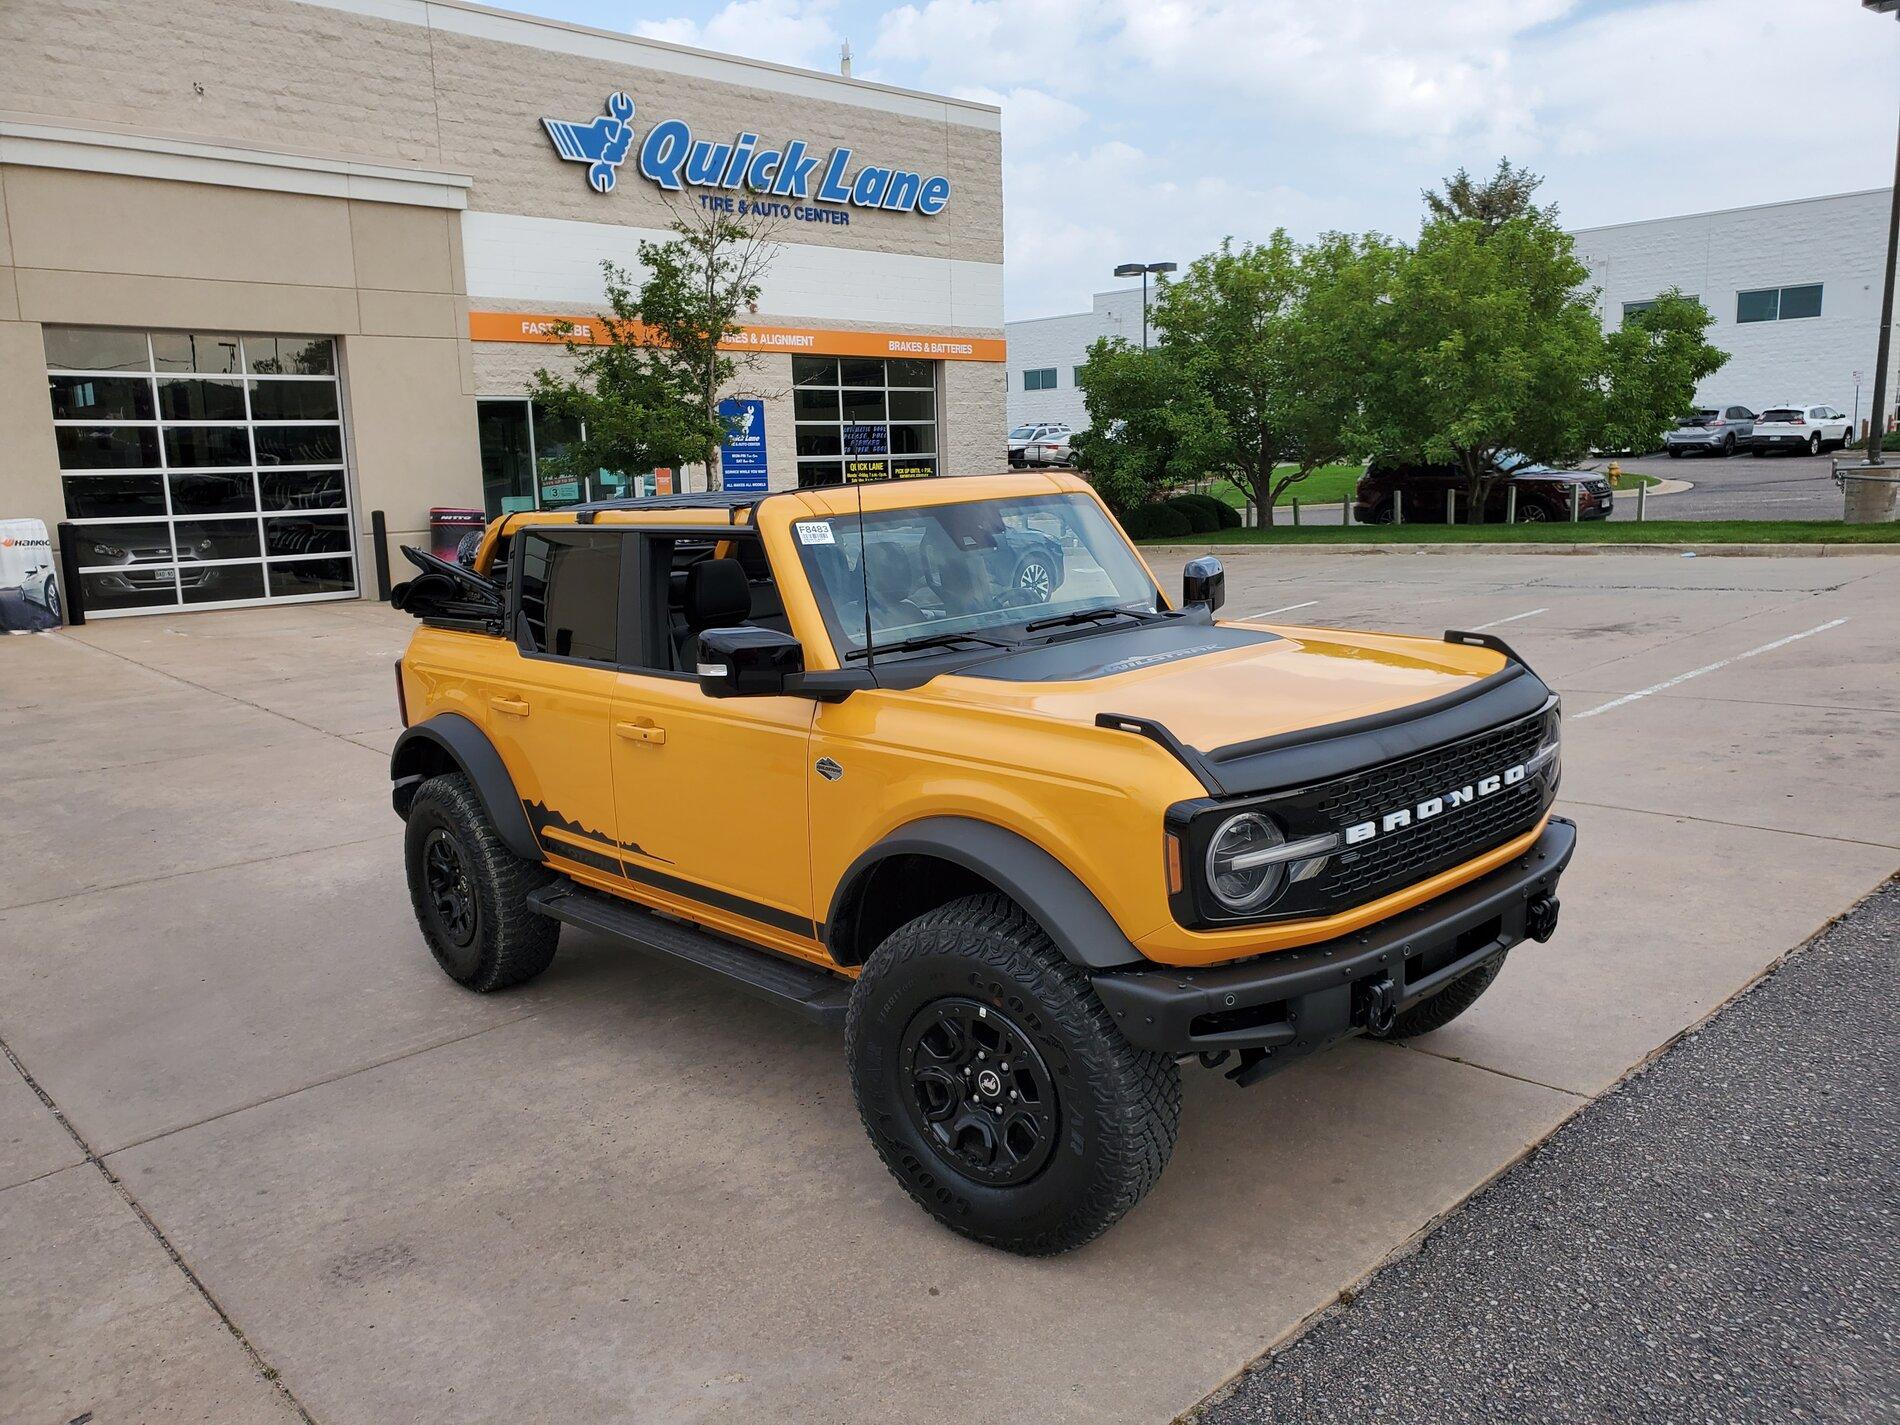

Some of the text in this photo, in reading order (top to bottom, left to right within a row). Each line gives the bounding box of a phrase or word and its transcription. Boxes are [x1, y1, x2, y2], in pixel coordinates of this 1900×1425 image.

[638, 119, 951, 216] Quick Lane
[699, 195, 850, 225] TIRE & AUTO CENTER
[750, 333, 758, 344] &
[760, 333, 814, 347] ALIGNMENT
[888, 340, 973, 354] BRAKES & BATTERIES
[850, 462, 884, 471] QUICK LANE
[799, 525, 829, 534] F8483
[1345, 764, 1525, 845] BRONCO
